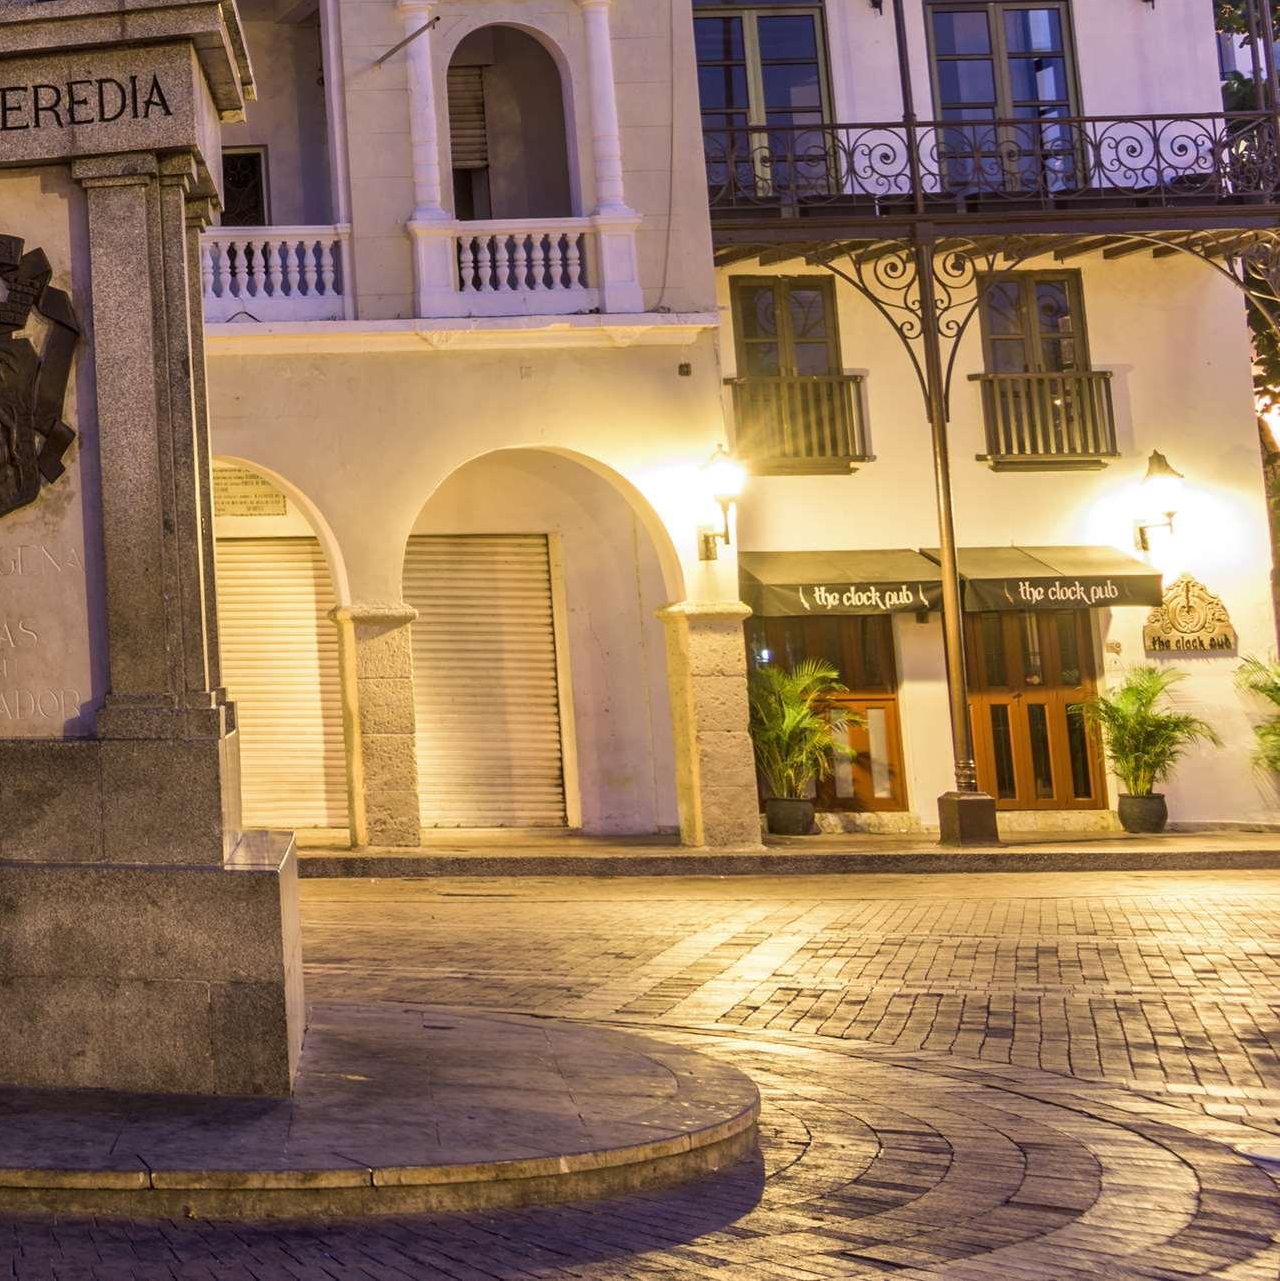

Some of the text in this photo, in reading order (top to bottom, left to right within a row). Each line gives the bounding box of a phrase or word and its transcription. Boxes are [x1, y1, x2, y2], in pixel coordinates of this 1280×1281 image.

[813, 584, 913, 610] the clock pub
[1018, 579, 1119, 605] the clock pub
[1152, 634, 1232, 652] the clock pub
